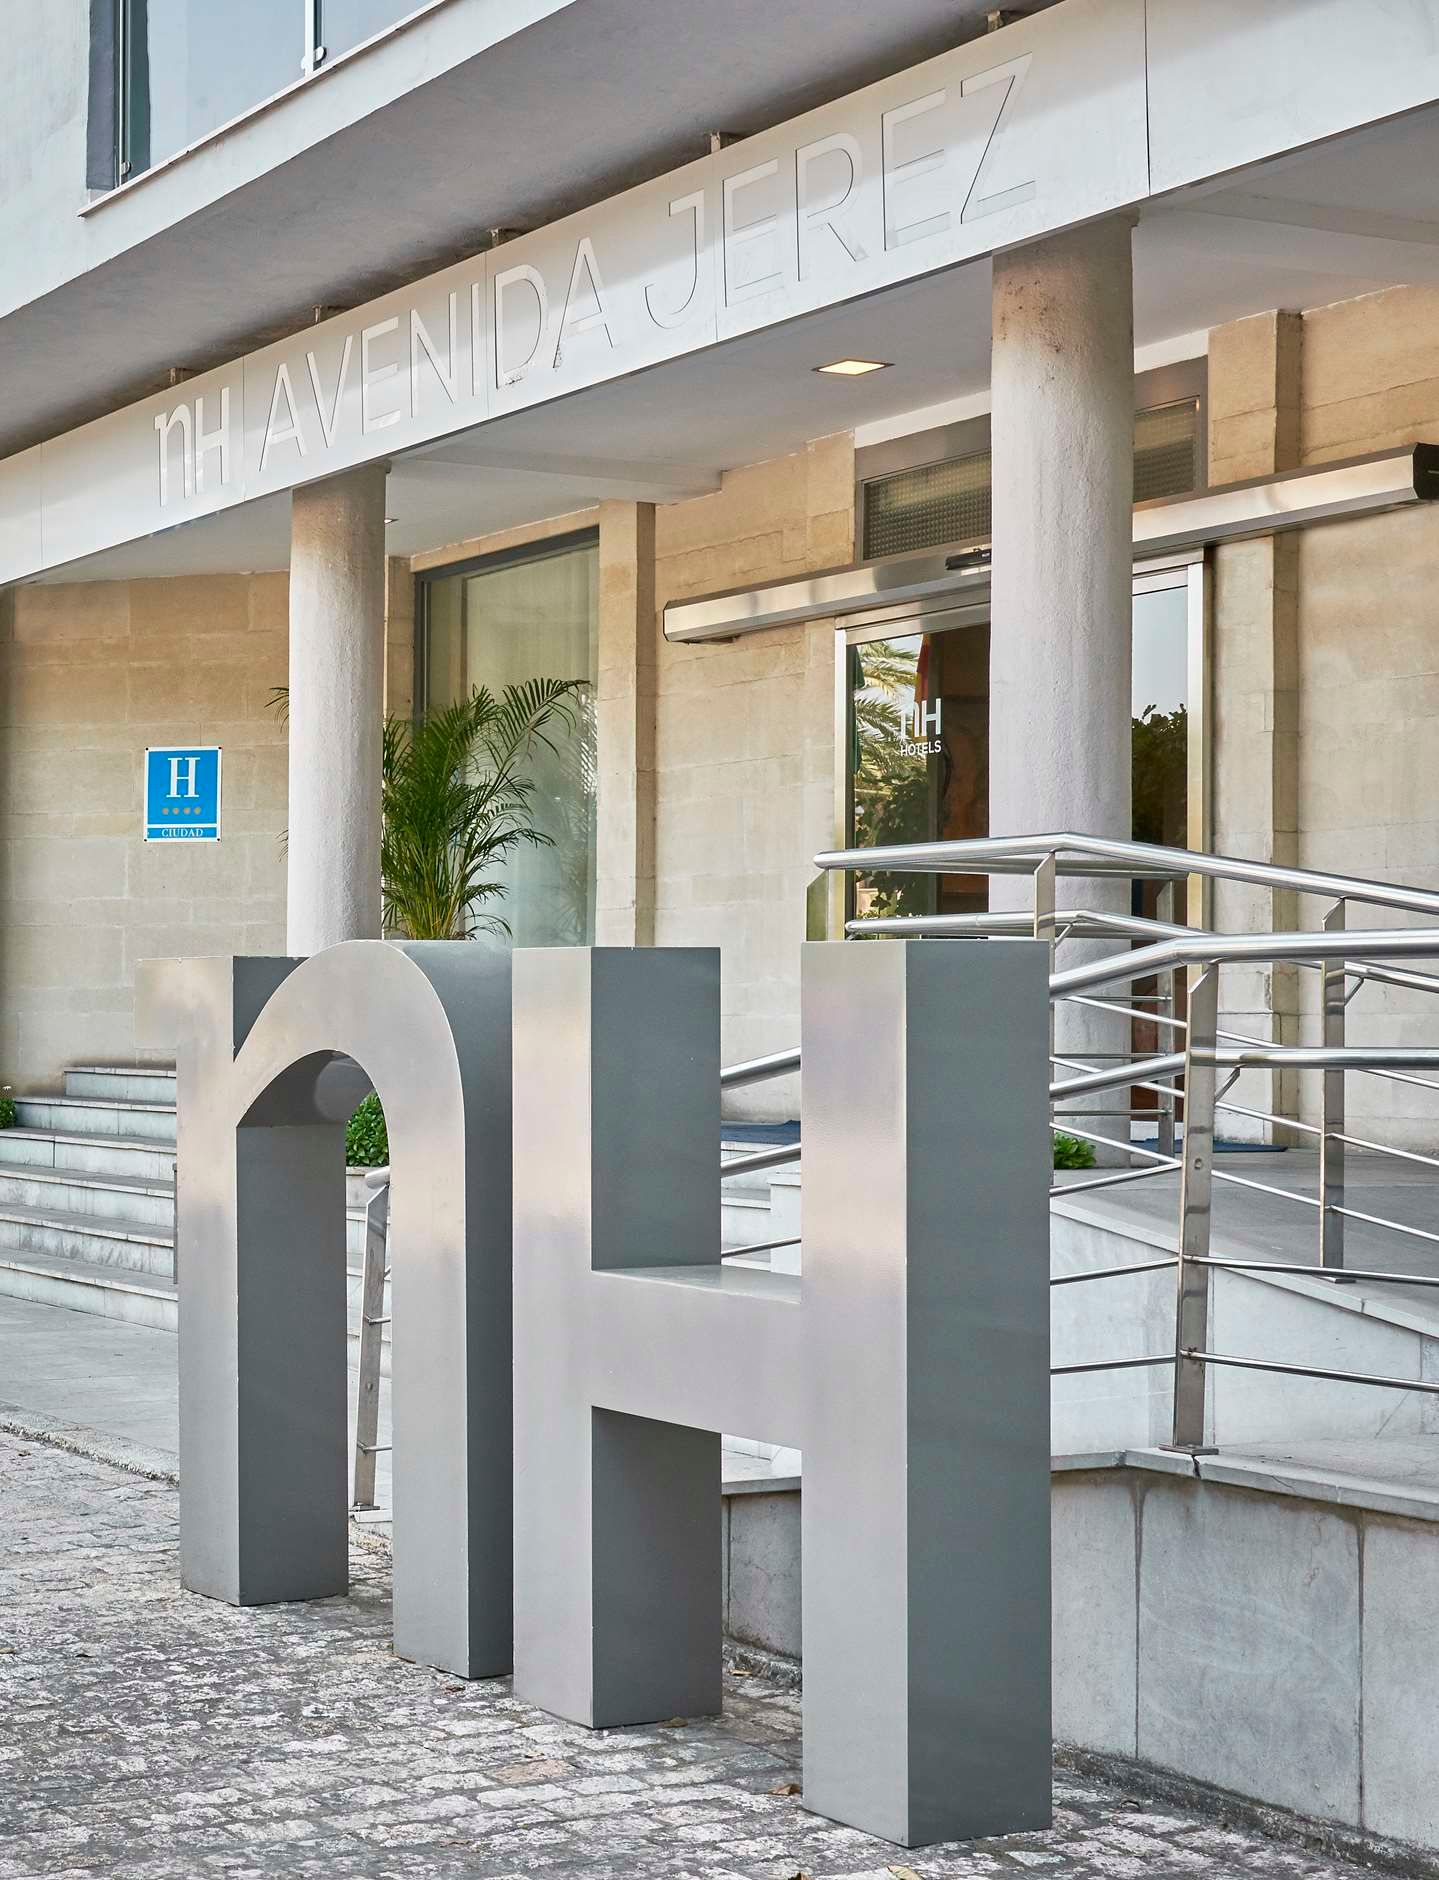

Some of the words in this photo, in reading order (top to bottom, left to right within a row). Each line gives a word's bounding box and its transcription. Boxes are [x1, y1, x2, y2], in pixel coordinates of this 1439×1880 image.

[258, 236, 614, 473] AVENIDA
[642, 51, 1036, 331] JEREZ
[900, 740, 942, 757] HOTELS
[165, 757, 201, 798] H
[161, 828, 204, 837] CIUDAD
